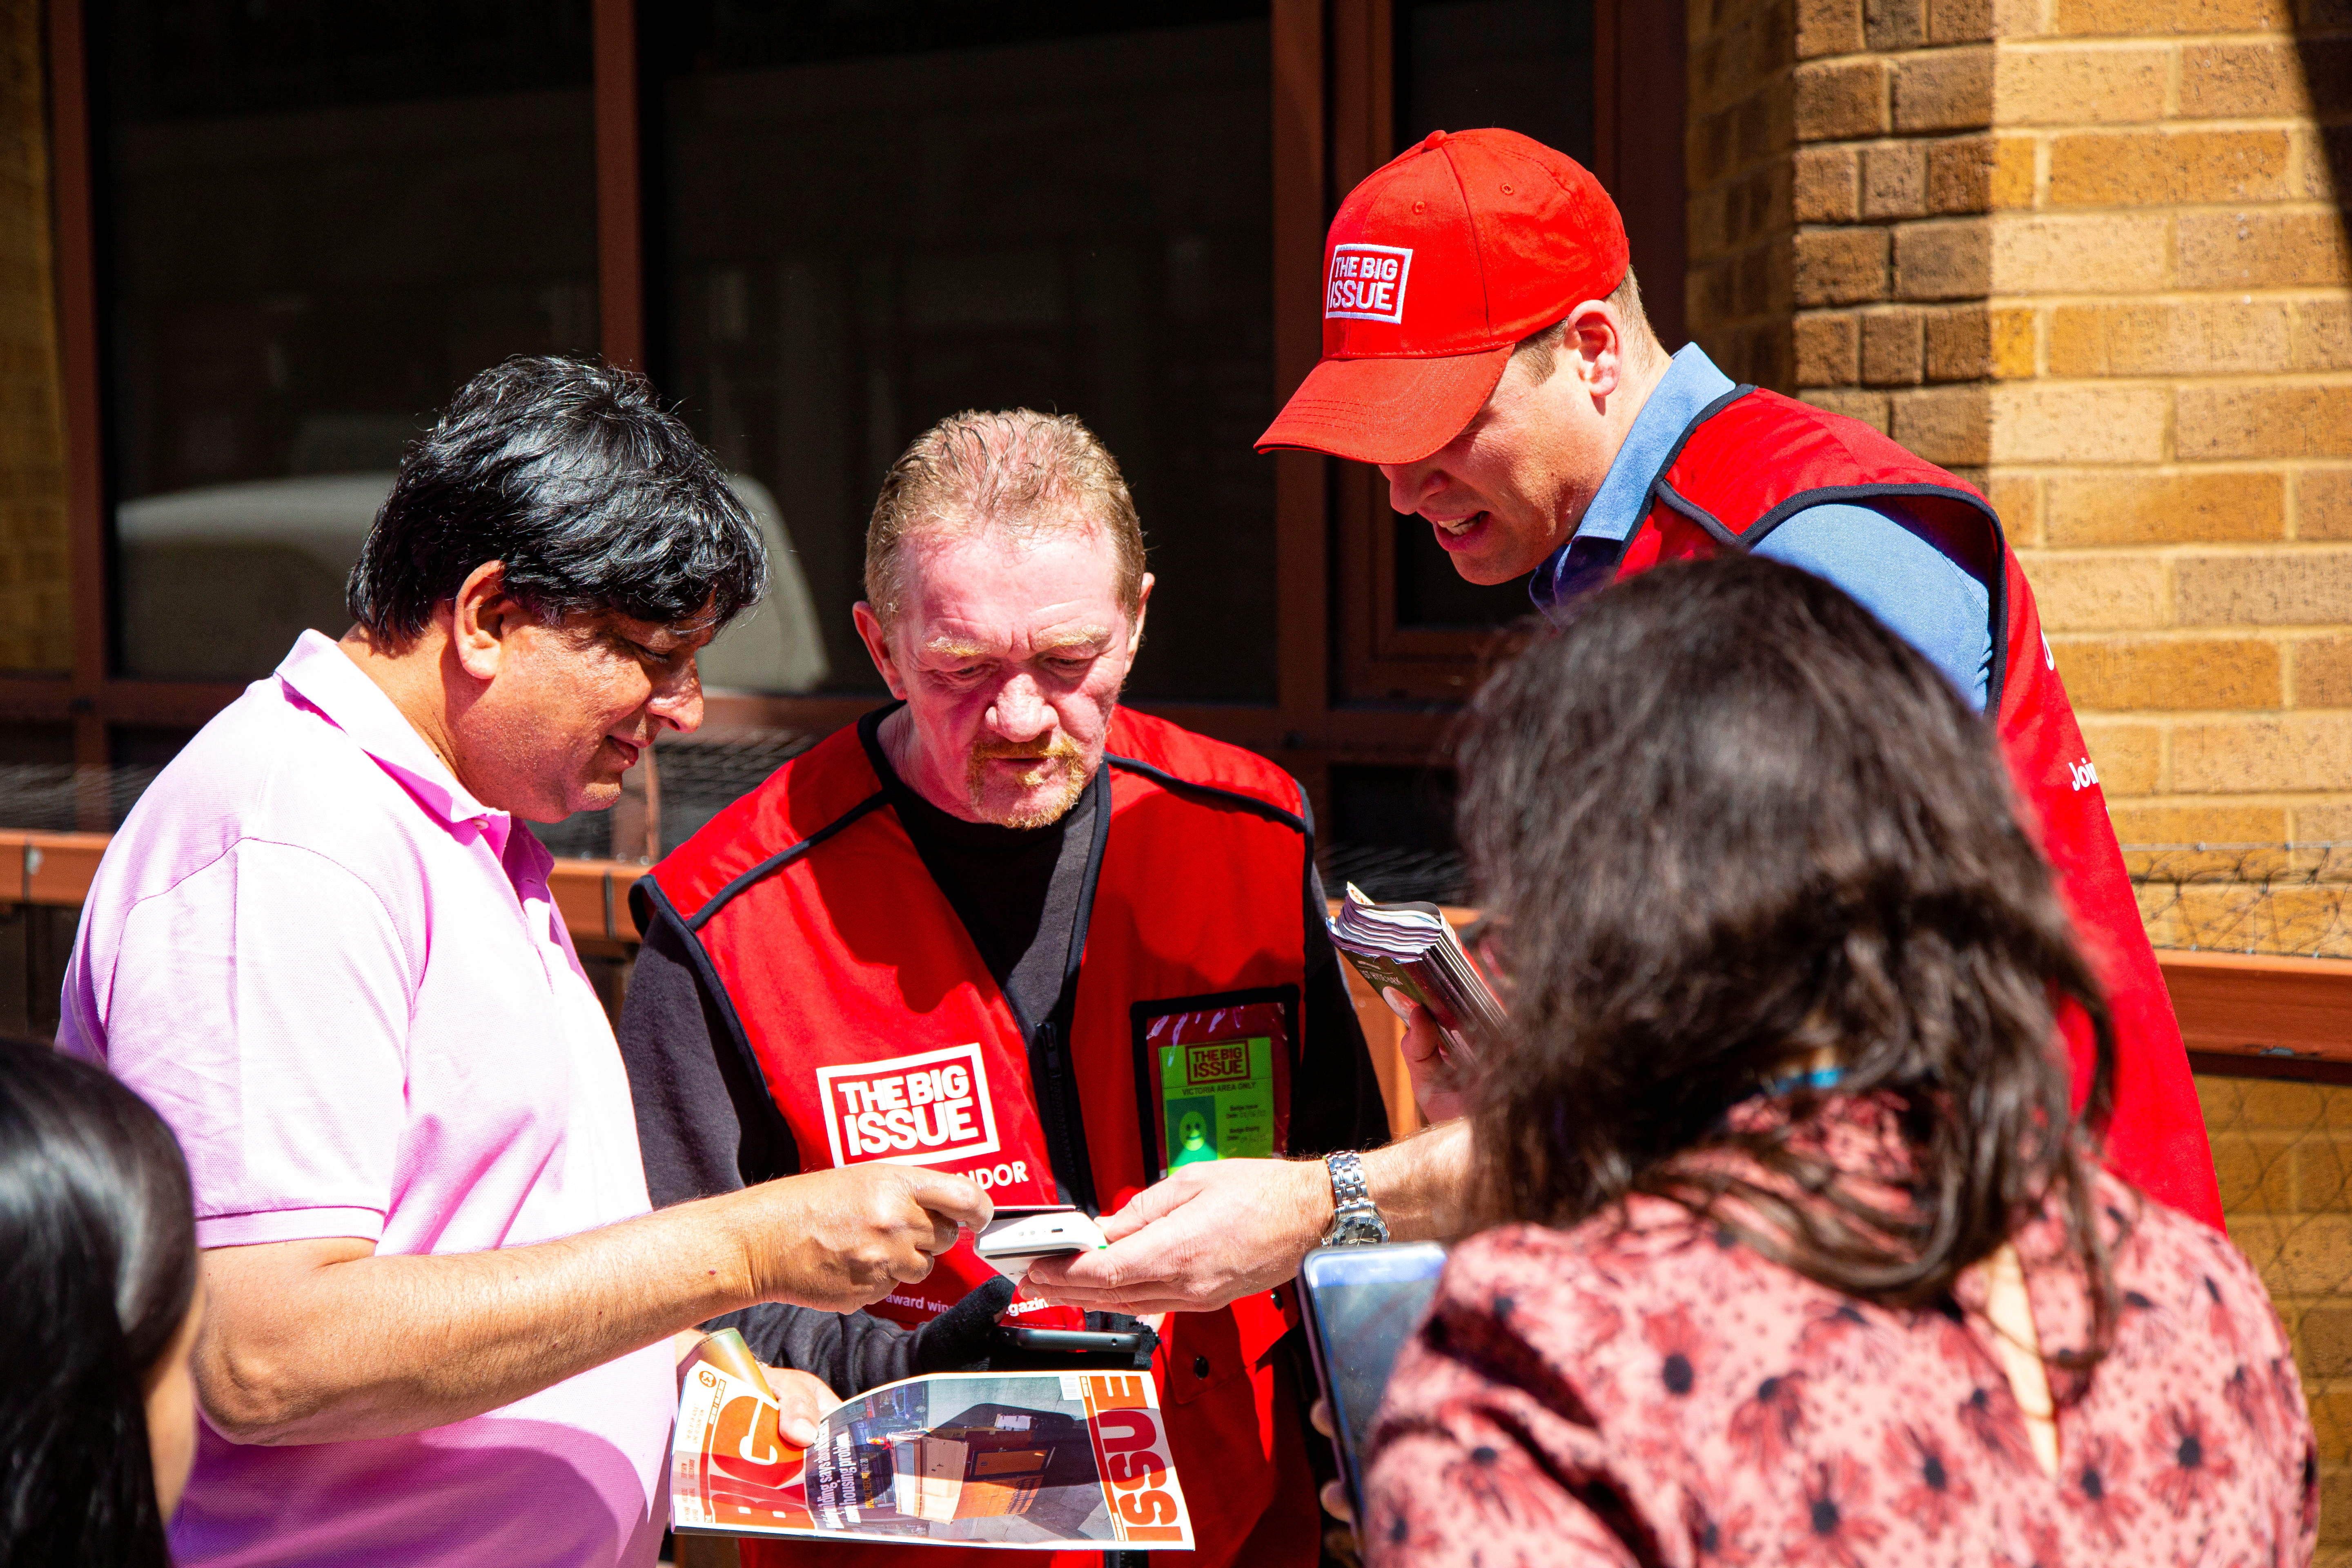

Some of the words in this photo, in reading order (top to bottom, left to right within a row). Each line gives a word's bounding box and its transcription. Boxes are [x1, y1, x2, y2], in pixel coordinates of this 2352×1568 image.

[1335, 256, 1360, 278] THE
[1360, 257, 1398, 281] BIG
[1330, 280, 1394, 310] ISSUE
[1192, 1050, 1219, 1062] THE
[1220, 1047, 1242, 1060] BIG
[1194, 1059, 1243, 1078] ISSUE
[837, 1076, 908, 1114] THE
[906, 1065, 970, 1107] BIG
[844, 1096, 979, 1156] ISSUE
[885, 1294, 925, 1309] award
[710, 1396, 815, 1530] BIG
[818, 1461, 836, 1483] says
[1089, 1376, 1183, 1541] ISSUE
[837, 1466, 857, 1506] housing
[861, 1472, 872, 1490] REPORT
